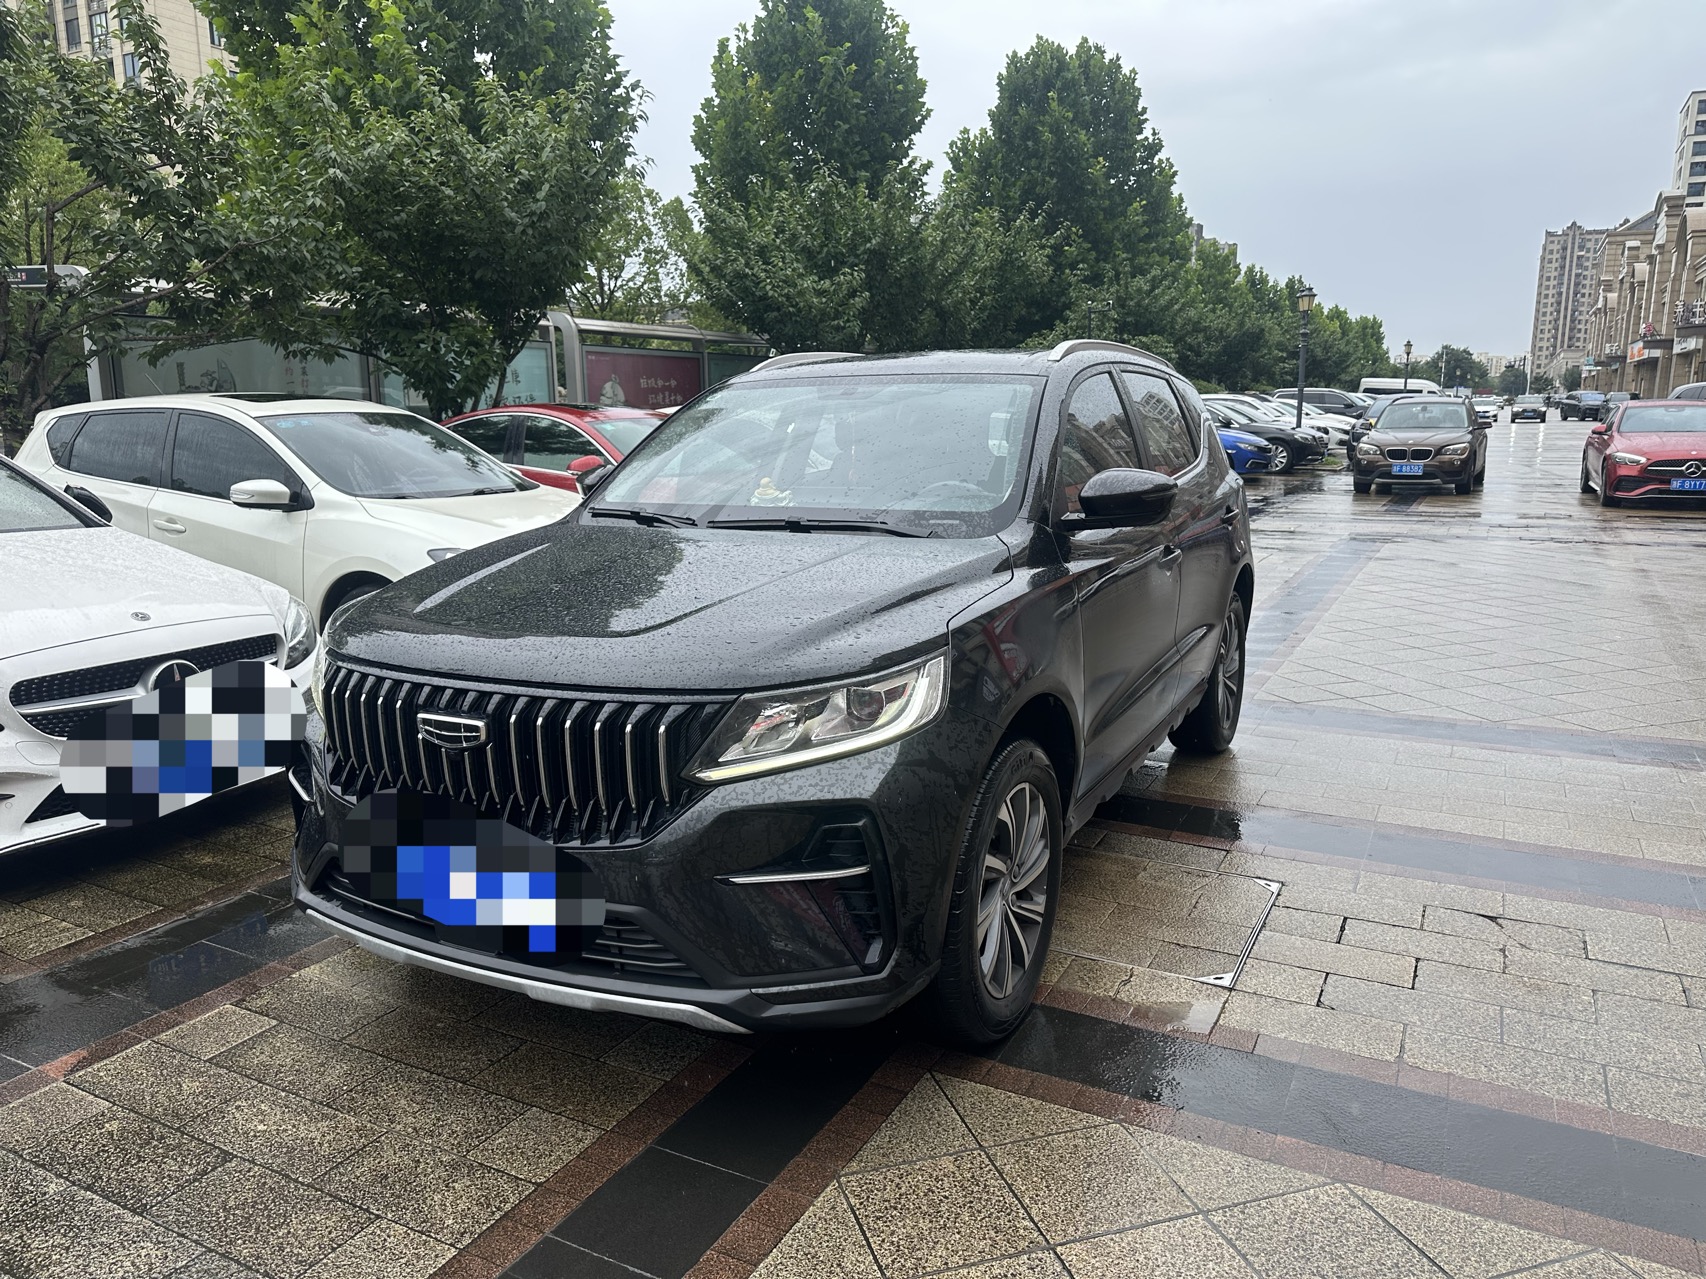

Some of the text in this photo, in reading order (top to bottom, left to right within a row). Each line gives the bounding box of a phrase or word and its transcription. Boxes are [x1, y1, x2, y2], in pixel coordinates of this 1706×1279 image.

[640, 375, 677, 389] 垃圾分一分
